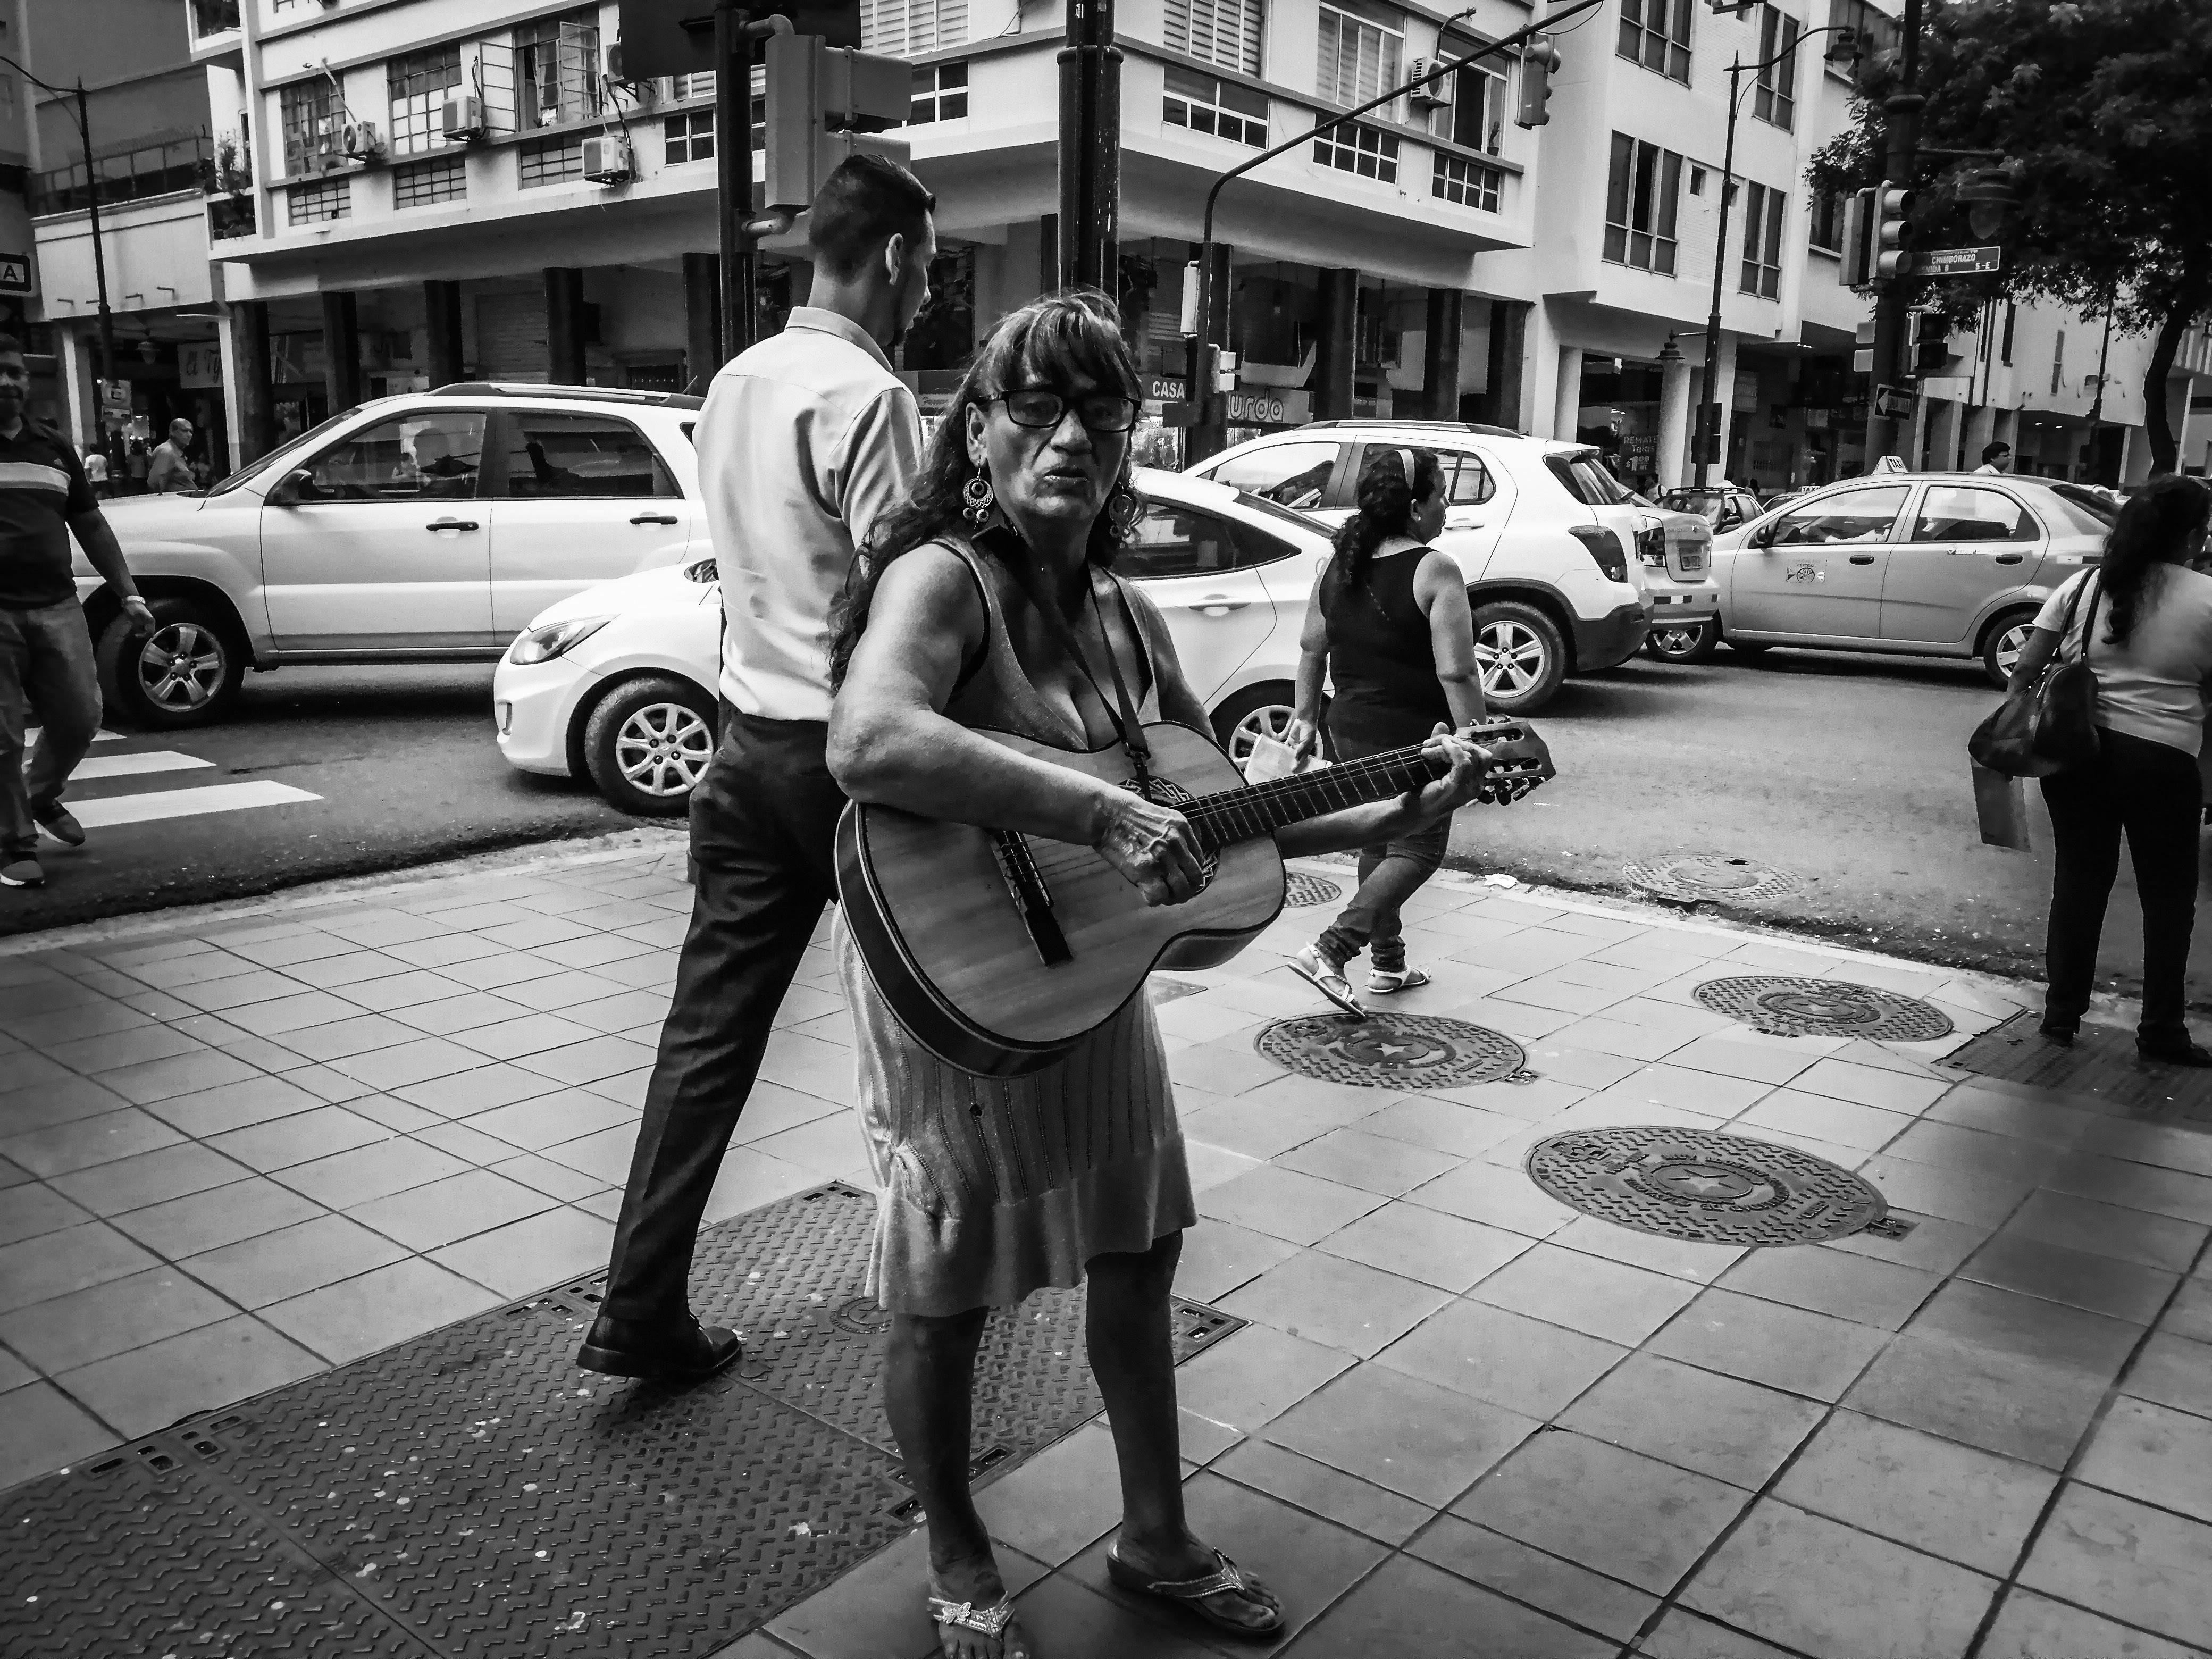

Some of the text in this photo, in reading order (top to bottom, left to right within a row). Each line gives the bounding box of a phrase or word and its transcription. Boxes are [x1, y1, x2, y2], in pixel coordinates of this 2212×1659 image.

[3, 265, 18, 281] A
[1152, 381, 1185, 398] CASA
[1229, 387, 1284, 422] urda
